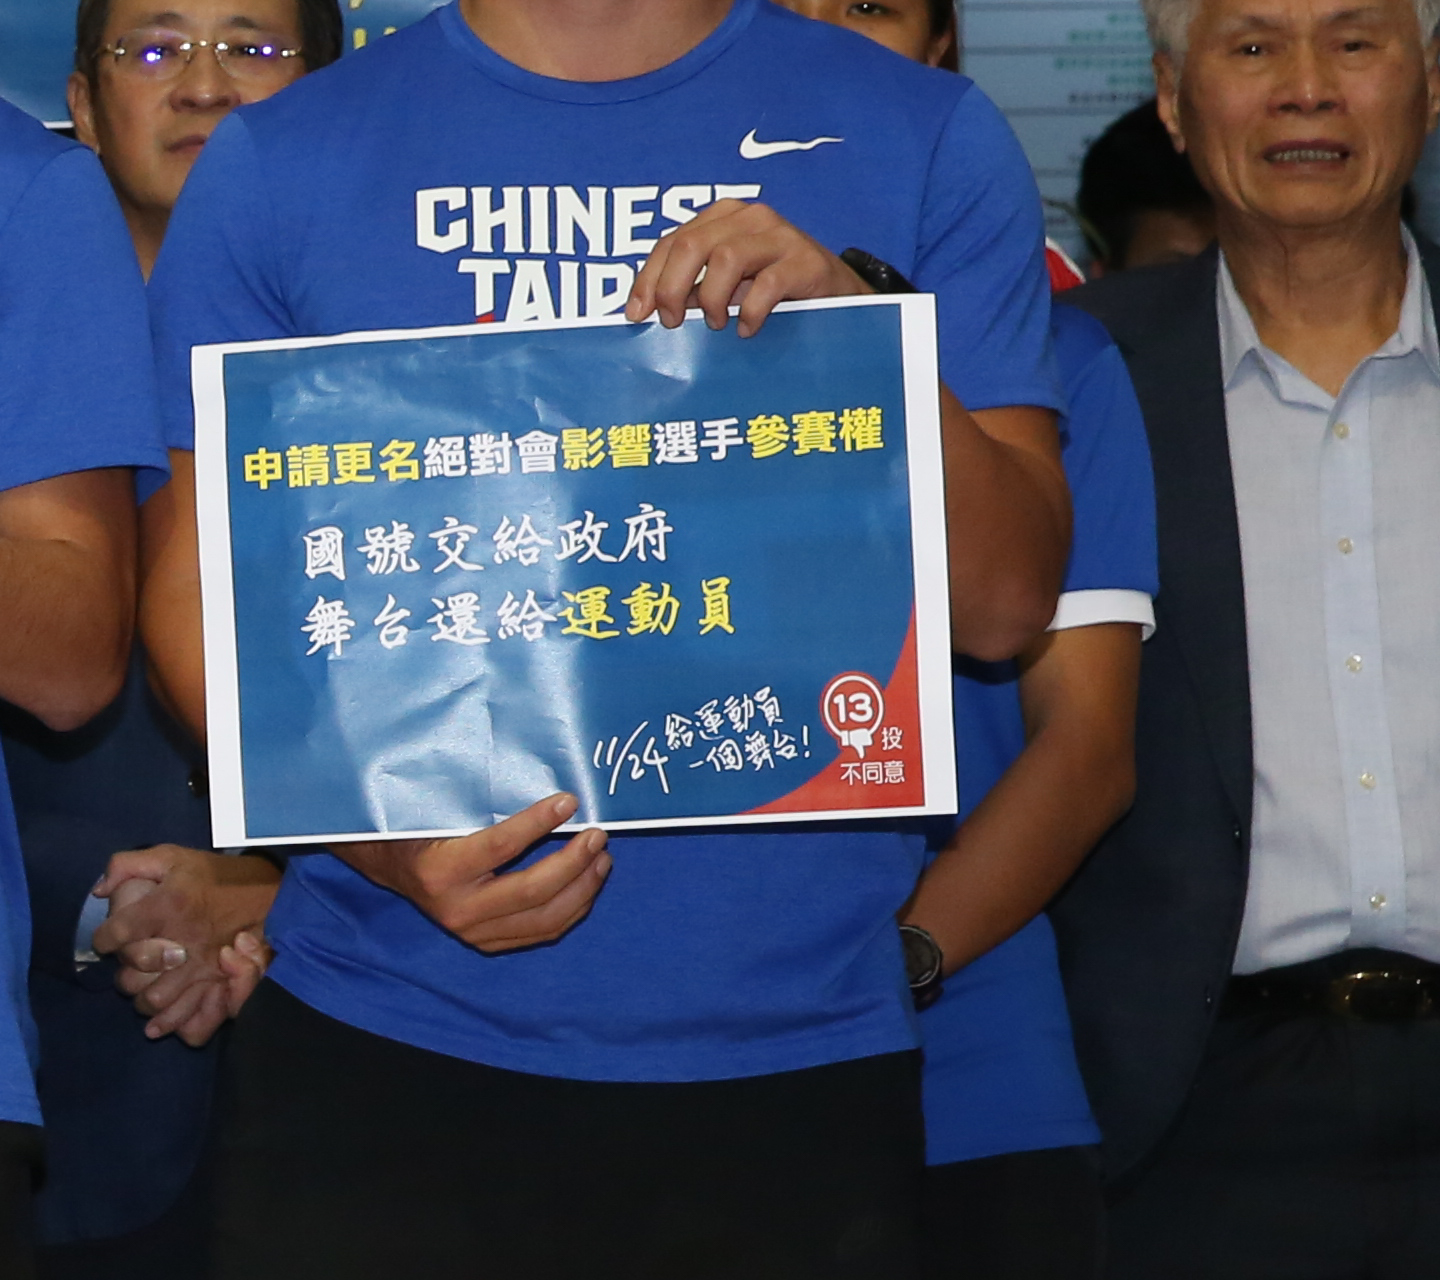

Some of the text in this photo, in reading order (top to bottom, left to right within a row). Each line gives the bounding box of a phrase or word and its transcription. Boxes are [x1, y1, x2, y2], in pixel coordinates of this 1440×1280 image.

[415, 183, 762, 255] CHINES
[243, 407, 885, 491] 申請更名絕對會影響選手參賽權
[301, 502, 674, 582] 國號交給政府
[301, 576, 736, 657] 舞台還給運動員
[664, 686, 784, 751] 給運動員
[833, 694, 874, 724] 13
[881, 726, 903, 752] 投
[592, 720, 670, 796] 11/24
[839, 757, 907, 786] 不同意
